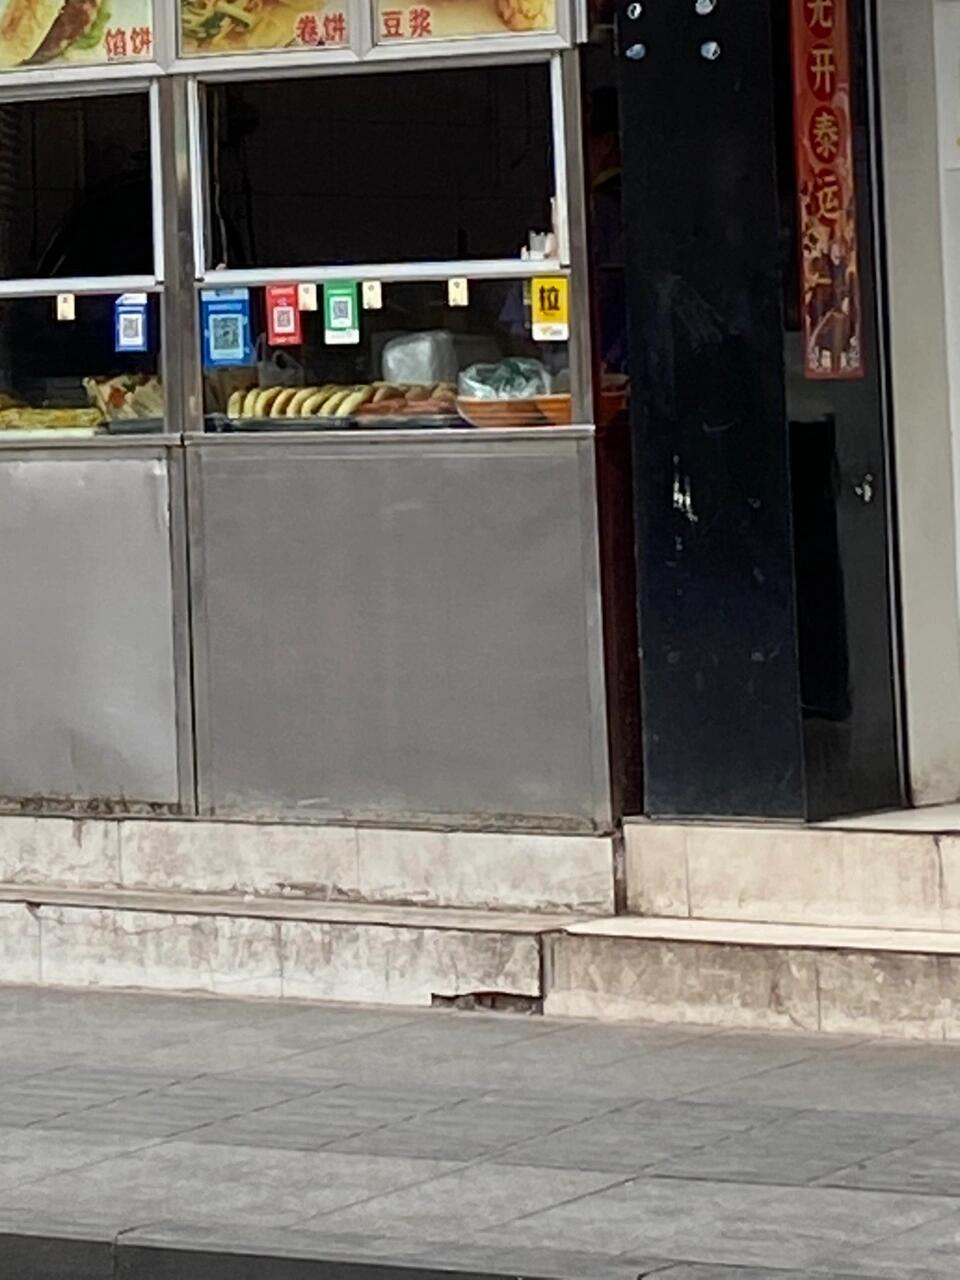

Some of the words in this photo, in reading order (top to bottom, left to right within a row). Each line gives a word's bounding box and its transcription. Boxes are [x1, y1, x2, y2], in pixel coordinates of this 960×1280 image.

[295, 12, 347, 45] 卷饼
[381, 9, 433, 39] 豆浆
[104, 25, 153, 57] 馅饼
